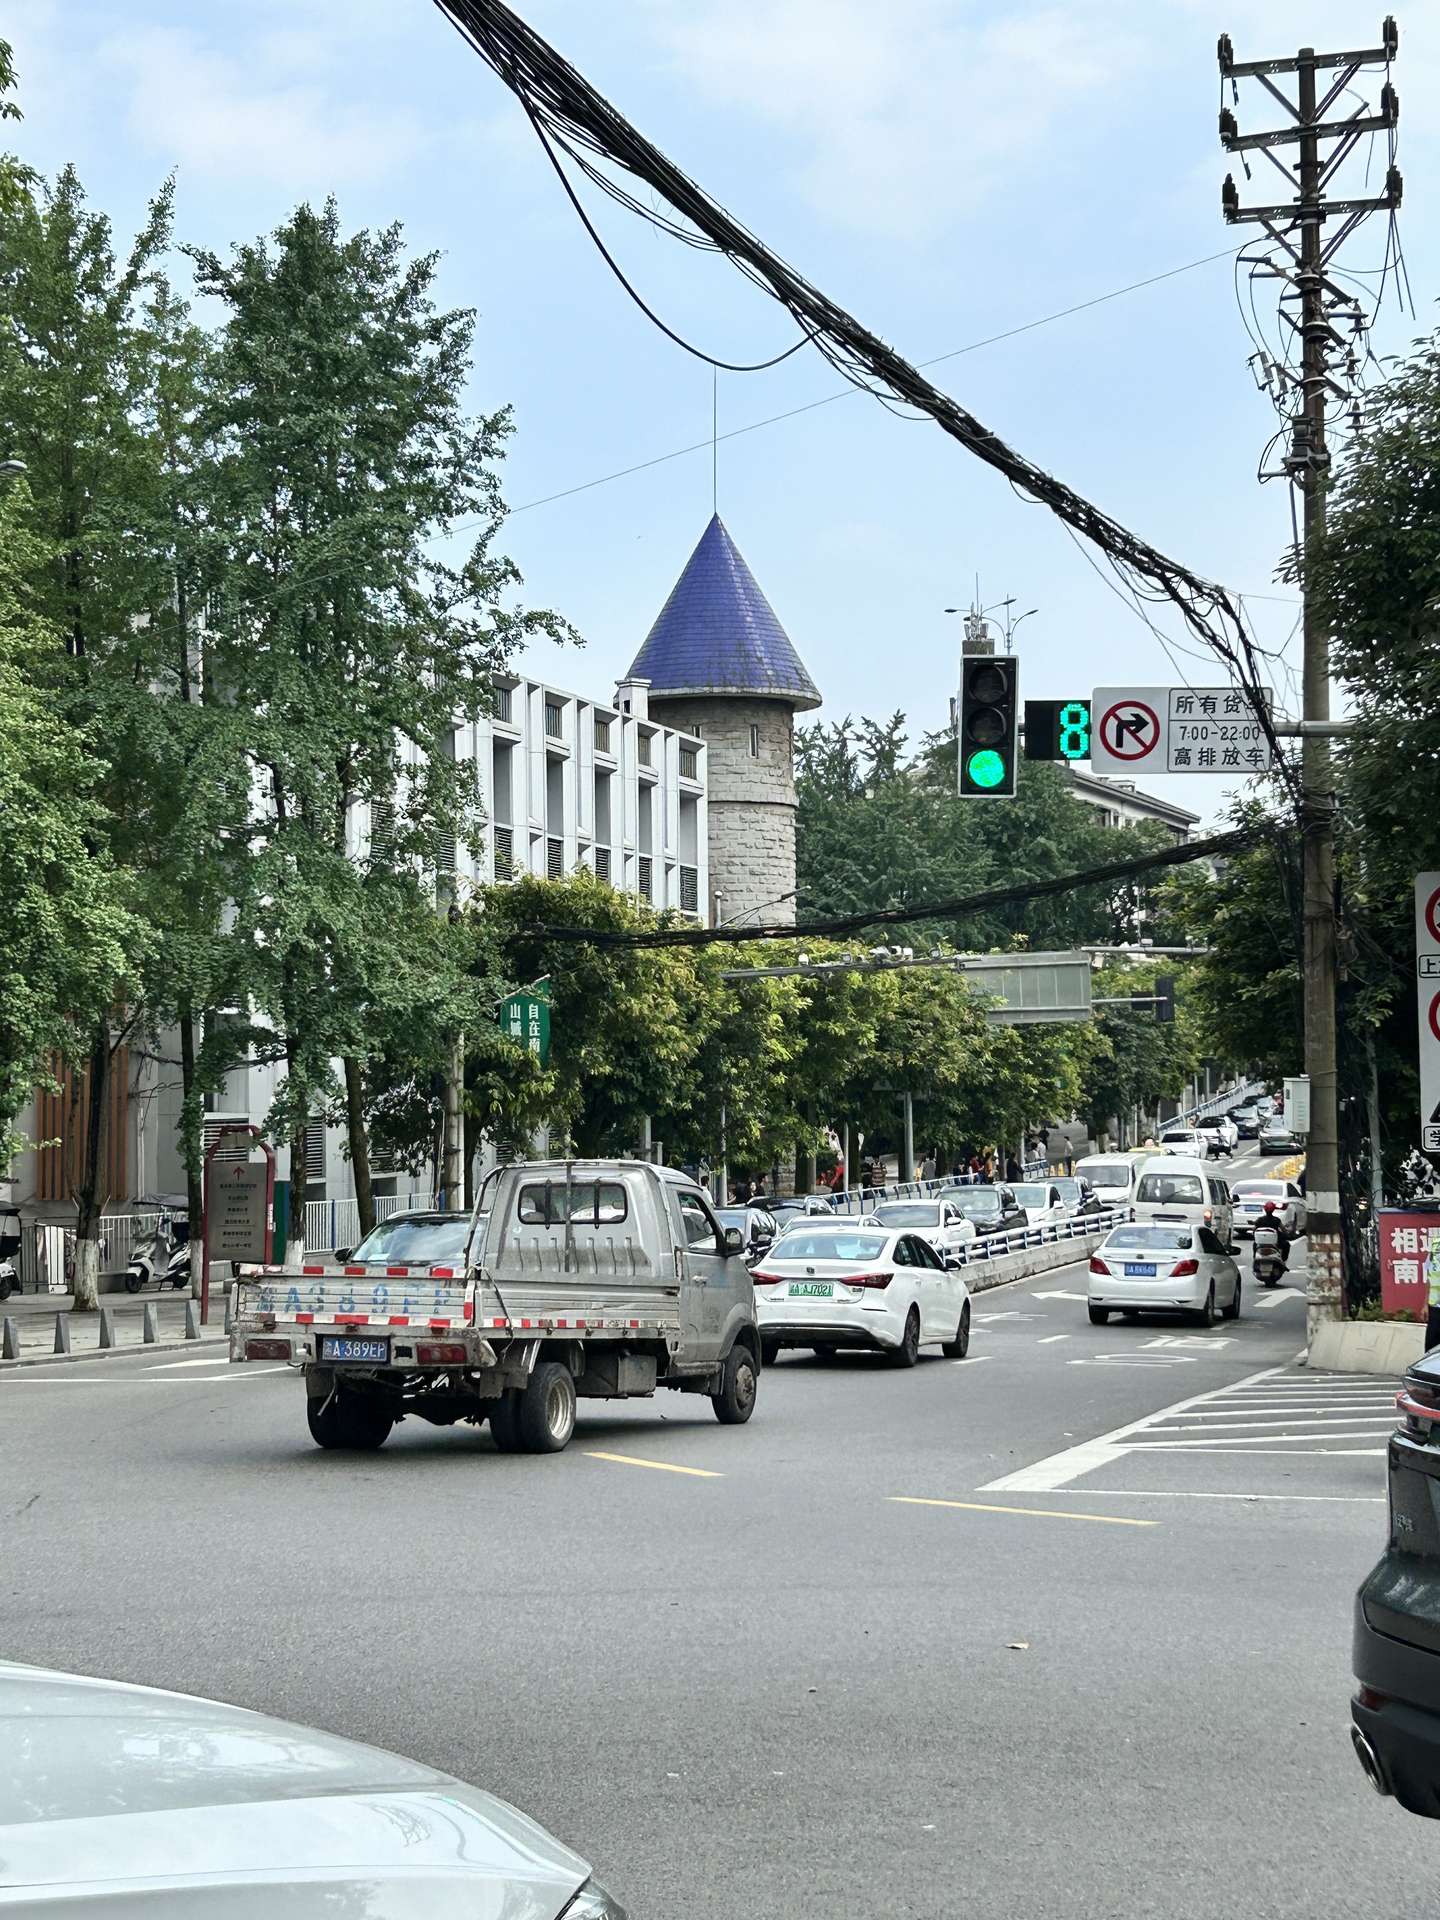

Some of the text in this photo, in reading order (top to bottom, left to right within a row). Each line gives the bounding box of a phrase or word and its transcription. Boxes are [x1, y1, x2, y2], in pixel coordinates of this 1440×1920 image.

[1060, 703, 1088, 758] 8
[1179, 725, 1260, 741] 7:00-22:00
[1174, 747, 1264, 766] 高排放车
[1421, 958, 1440, 974] 上
[1392, 1258, 1428, 1284] 南
